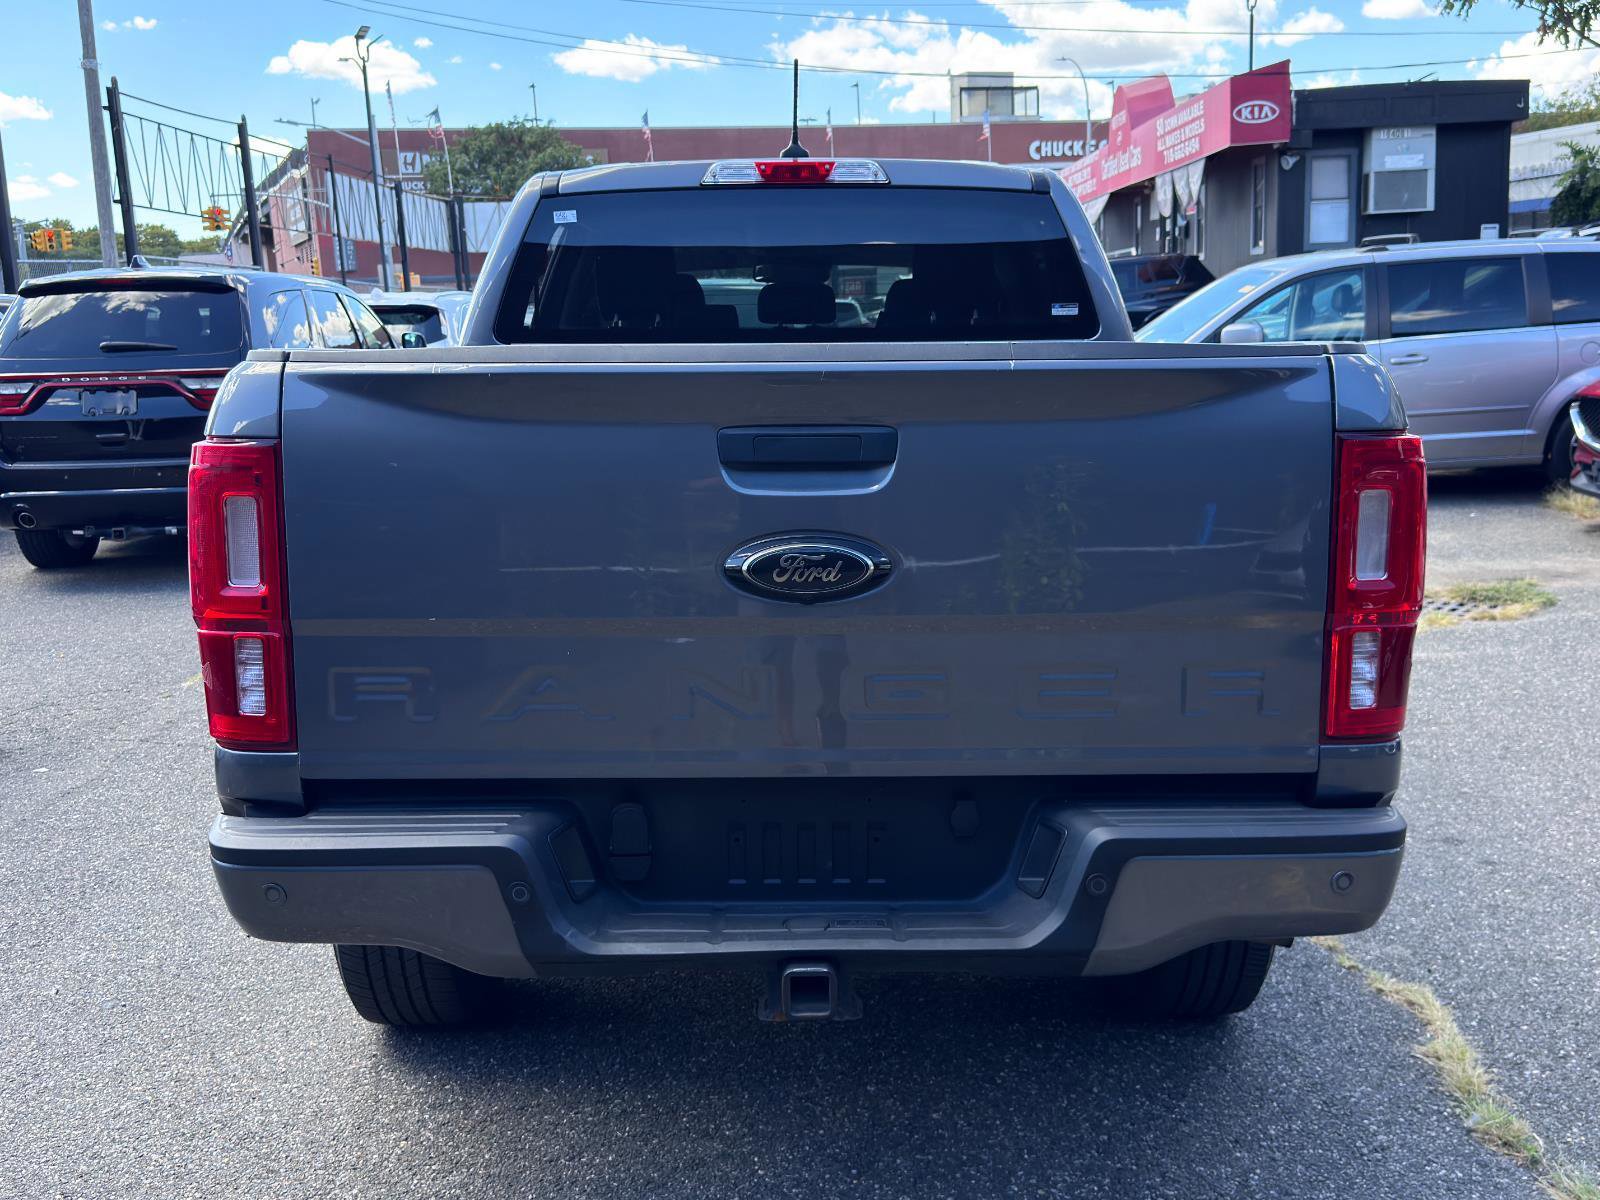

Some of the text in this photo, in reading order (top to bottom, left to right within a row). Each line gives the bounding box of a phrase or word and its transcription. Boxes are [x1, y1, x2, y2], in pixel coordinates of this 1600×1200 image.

[1177, 100, 1204, 126] AVAILABLE
[1241, 105, 1273, 120] KIA
[1184, 118, 1204, 139] MODELS
[1029, 140, 1084, 160] CHUCK
[772, 553, 844, 583] Ford
[328, 665, 1282, 722] RANGER
